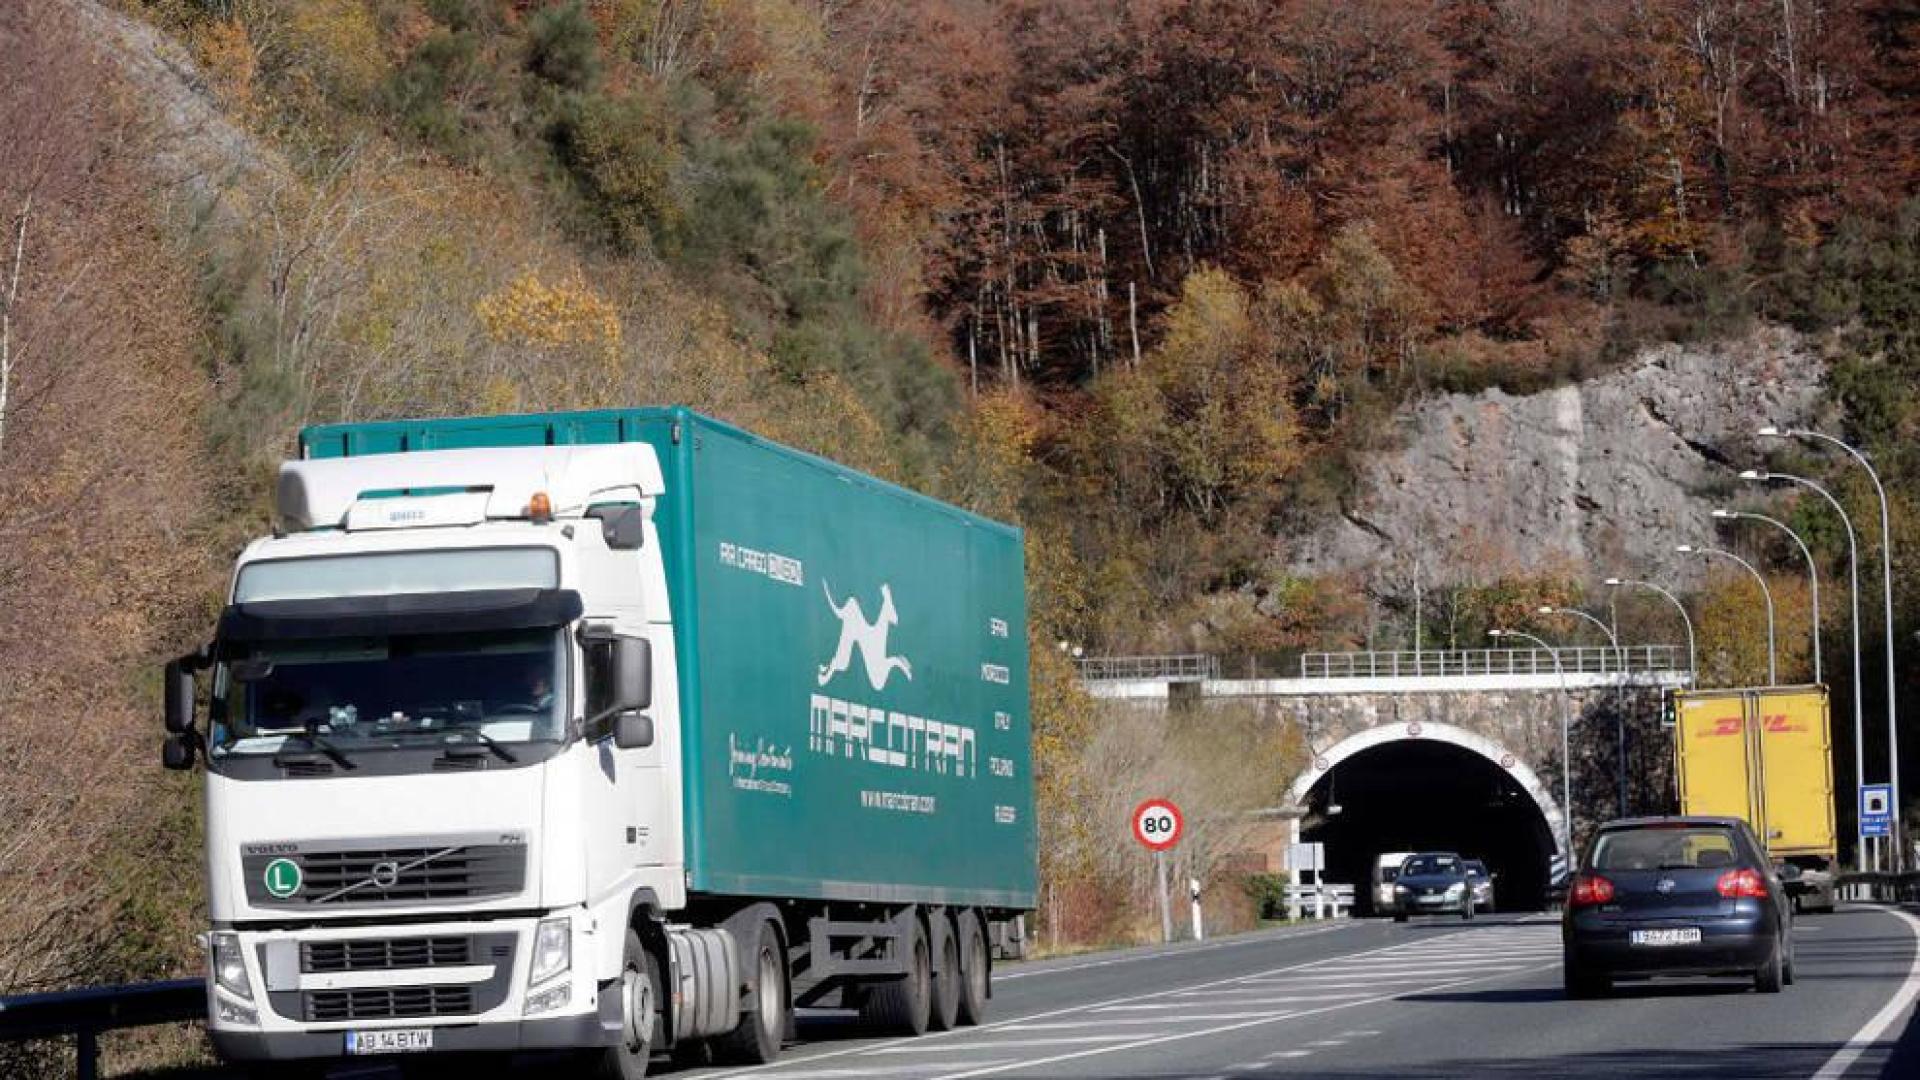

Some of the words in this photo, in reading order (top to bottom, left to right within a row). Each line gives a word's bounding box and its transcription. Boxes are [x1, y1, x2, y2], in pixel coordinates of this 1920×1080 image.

[1712, 714, 1794, 736] DHL
[811, 694, 976, 779] MARCOTRAN
[1144, 816, 1172, 833] 80
[248, 844, 298, 855] VOLVO
[273, 867, 291, 890] L
